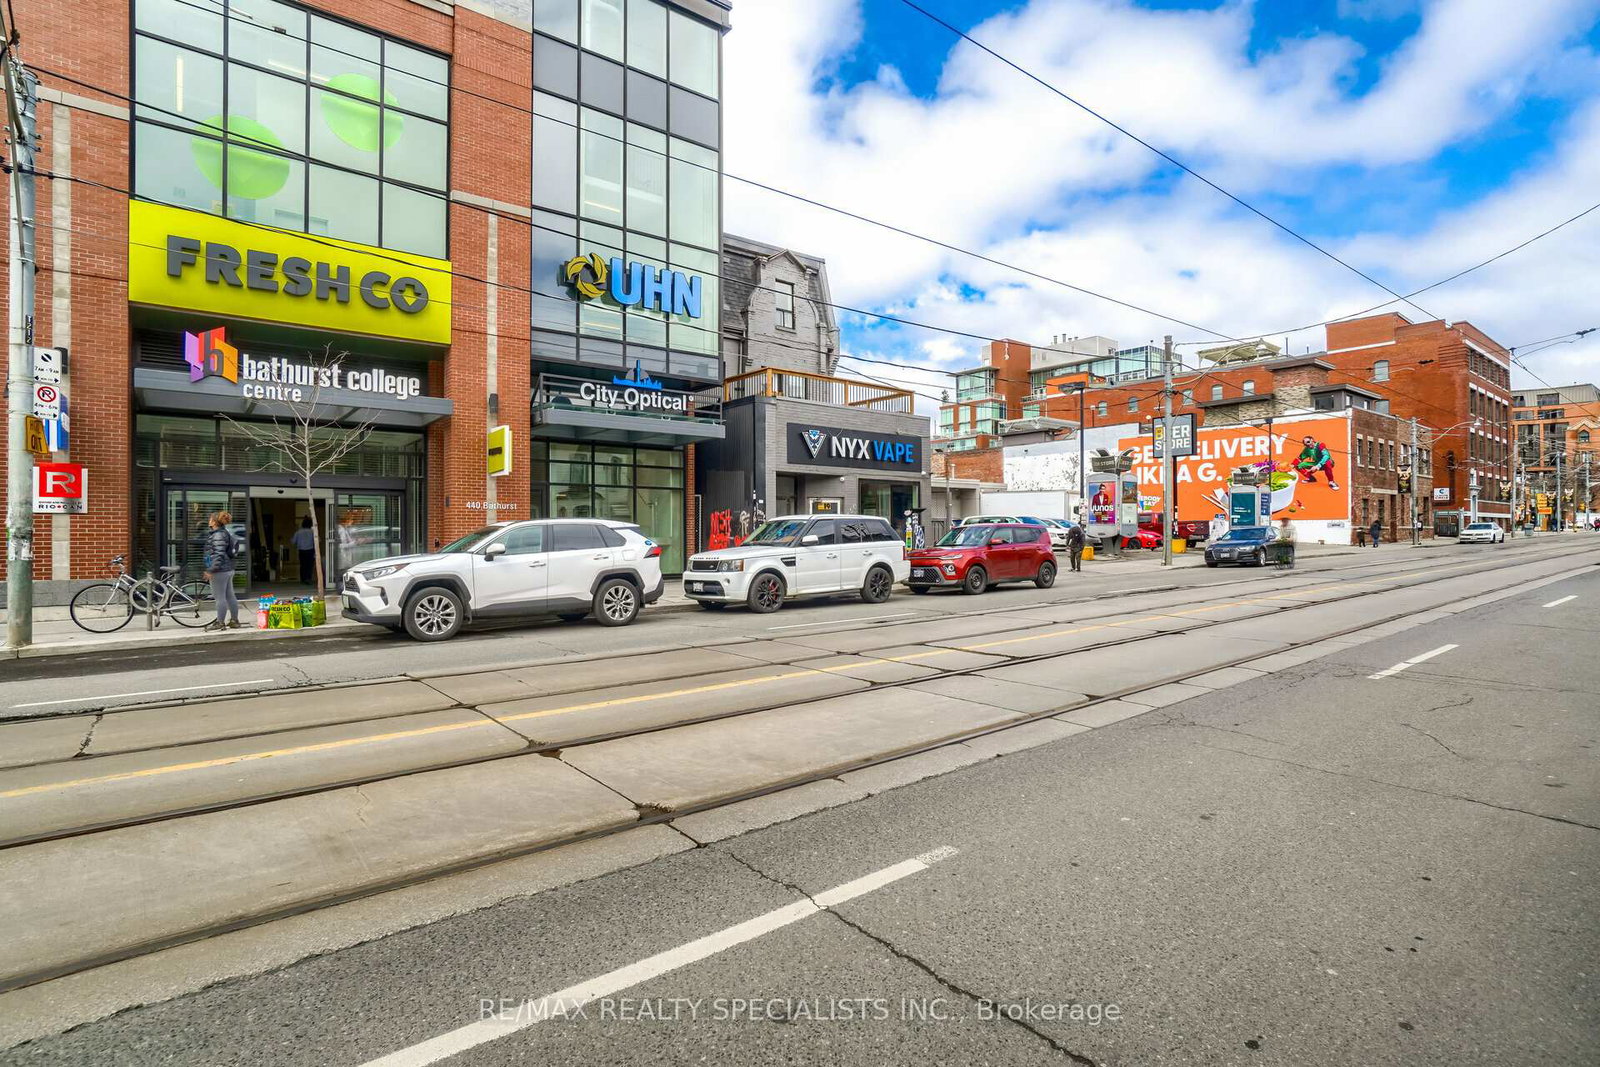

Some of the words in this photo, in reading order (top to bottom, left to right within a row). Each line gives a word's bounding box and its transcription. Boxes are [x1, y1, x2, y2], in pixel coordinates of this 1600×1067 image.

[167, 235, 350, 303] FRESH
[360, 272, 429, 314] CO
[610, 257, 701, 318] UHN
[243, 353, 342, 388] bathurst
[347, 368, 420, 400] college
[243, 384, 302, 402] centre
[580, 382, 618, 407] City
[624, 387, 687, 411] Optical
[1155, 425, 1190, 440] BER
[1155, 438, 1190, 450] SRE
[830, 436, 870, 460] NYX
[874, 441, 915, 463] VAPE
[1130, 446, 1164, 465] GE
[1177, 433, 1288, 461] LIVERY
[46, 471, 75, 493] R
[1177, 464, 1193, 483] A
[1197, 463, 1223, 482] G.
[466, 501, 480, 509] 440
[483, 501, 517, 510] Bathurst
